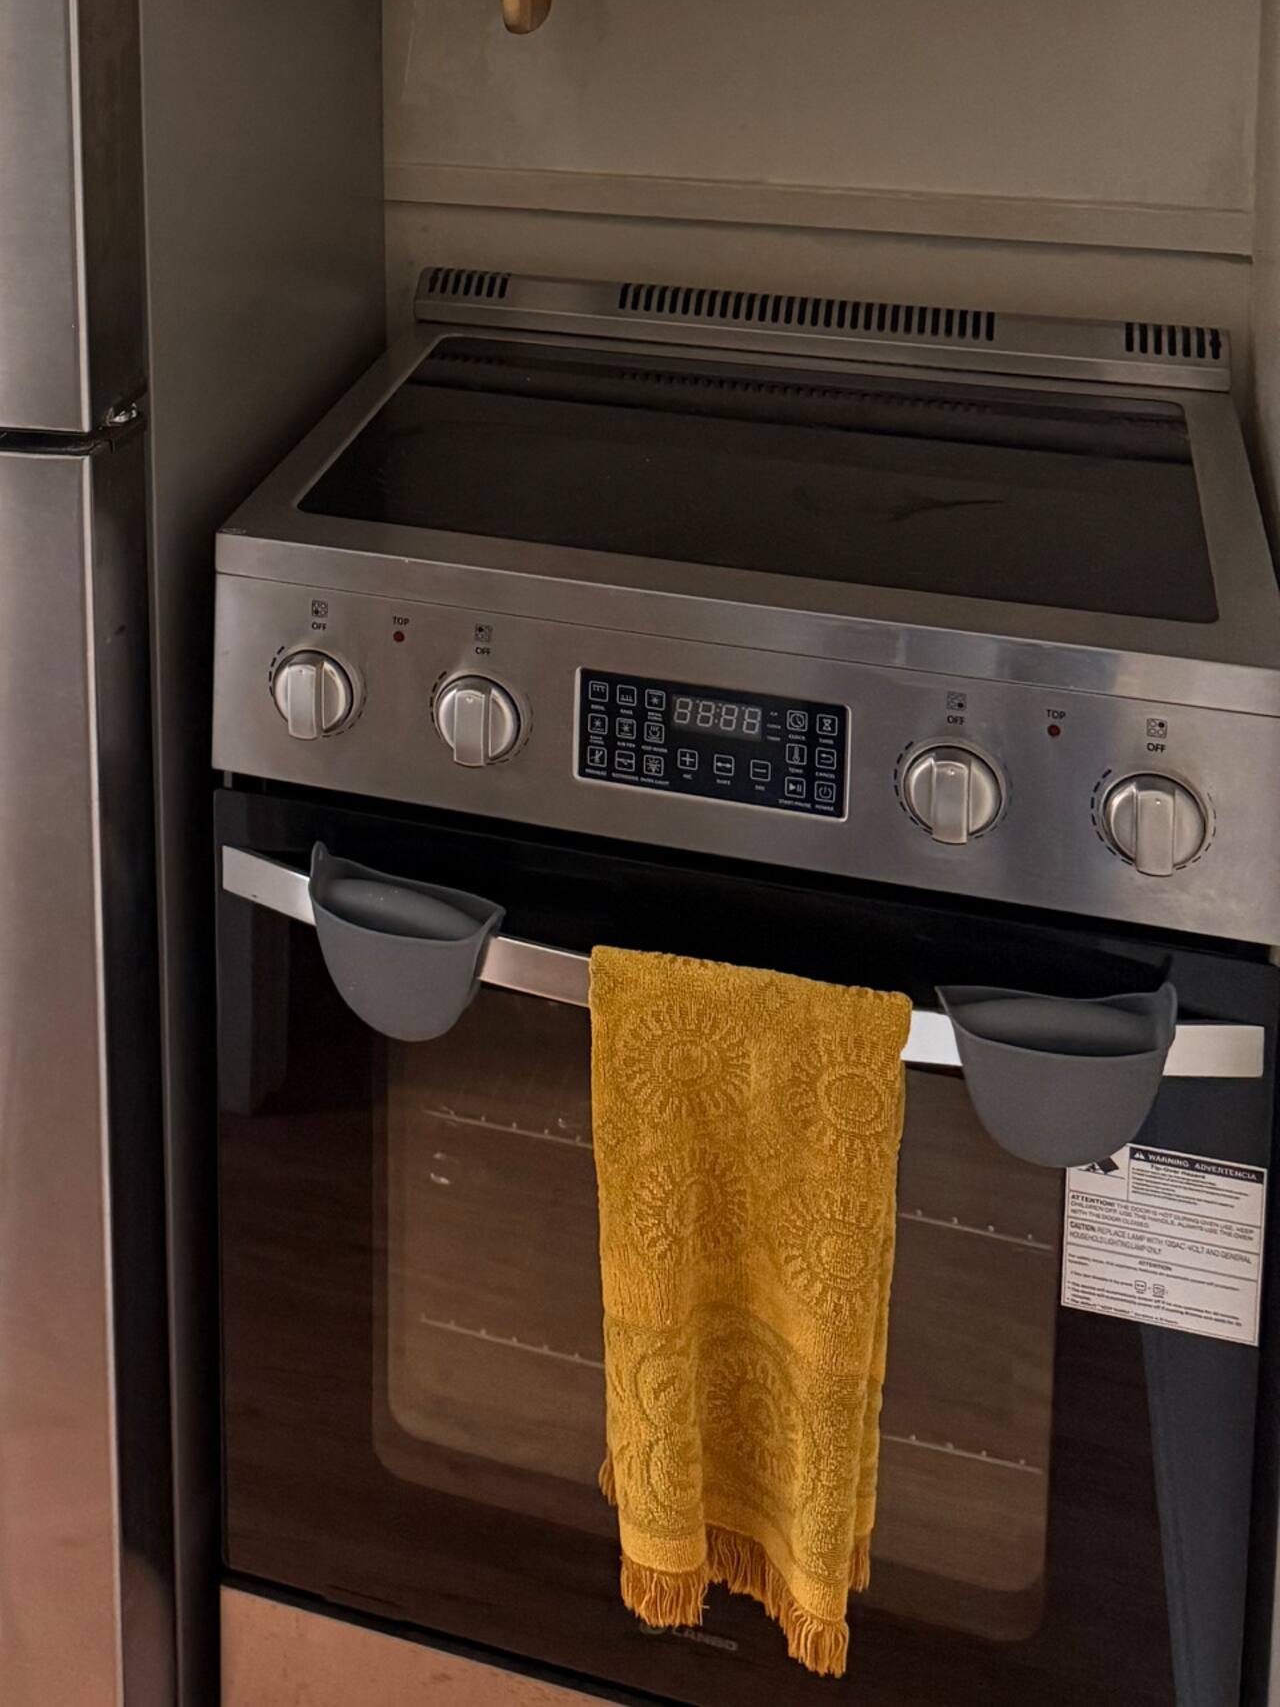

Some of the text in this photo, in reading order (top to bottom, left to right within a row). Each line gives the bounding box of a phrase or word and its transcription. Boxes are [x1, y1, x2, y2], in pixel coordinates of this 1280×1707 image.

[311, 621, 327, 631] OFF
[392, 616, 410, 626] TOP
[475, 646, 491, 656] OFF
[1046, 709, 1066, 720] TOP
[947, 715, 965, 725] OFF
[1146, 742, 1166, 753] OFF
[1147, 1153, 1258, 1181] WARNING ADVERTENCIA
